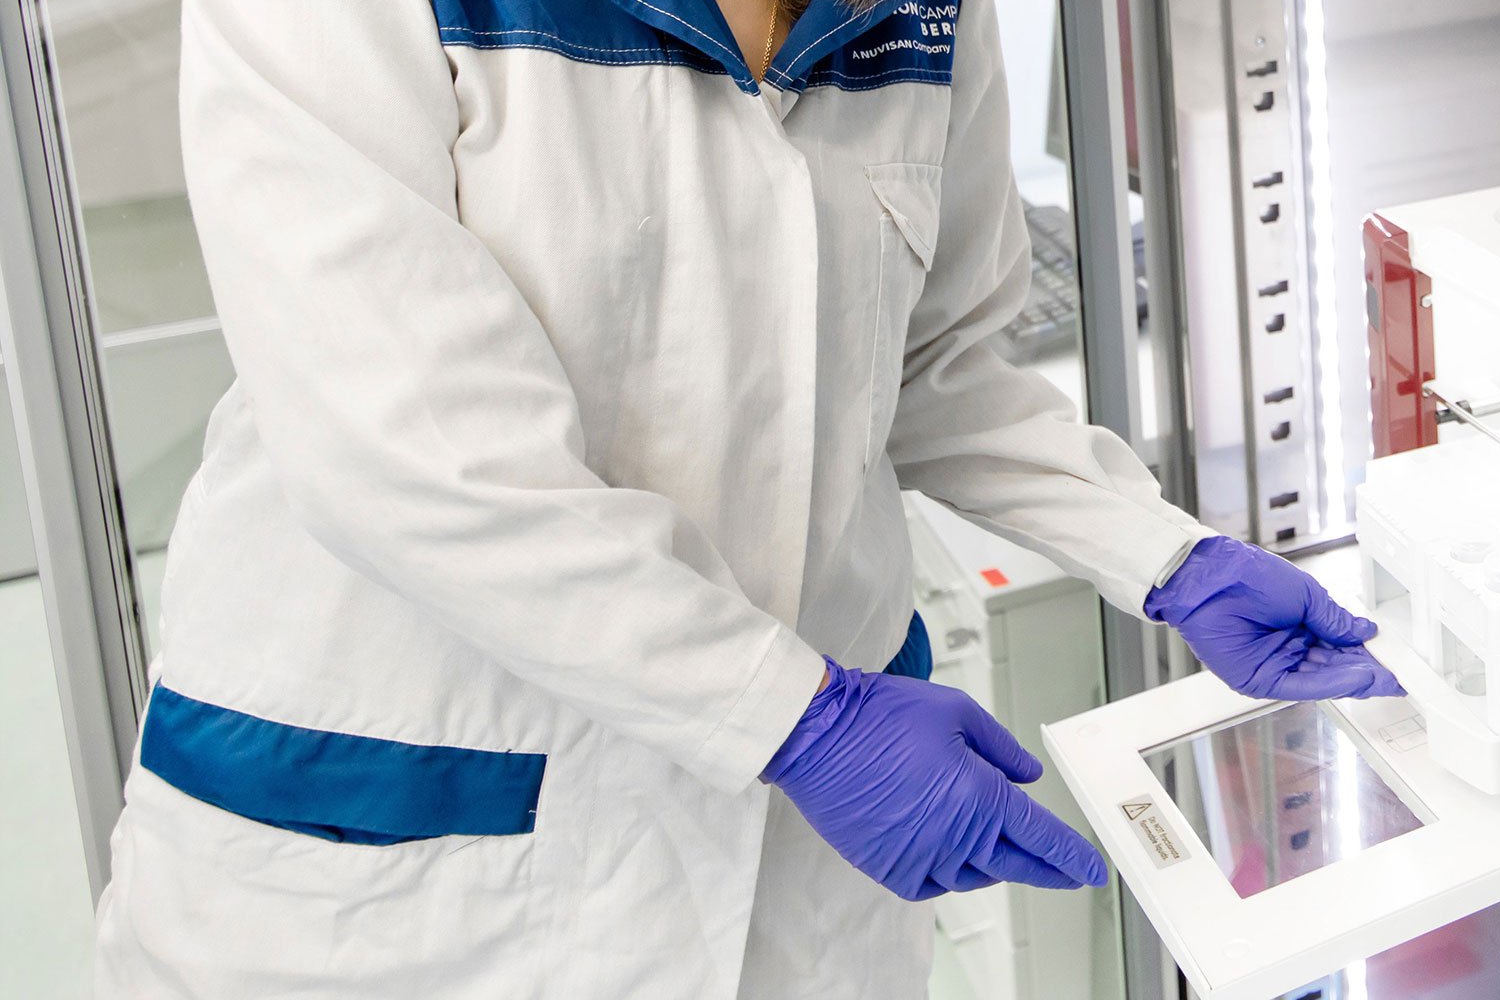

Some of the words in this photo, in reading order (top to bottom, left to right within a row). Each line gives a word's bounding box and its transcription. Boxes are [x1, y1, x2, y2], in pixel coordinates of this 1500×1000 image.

[852, 50, 860, 60] A
[860, 39, 912, 59] NUVISAN
[912, 39, 951, 54] Company
